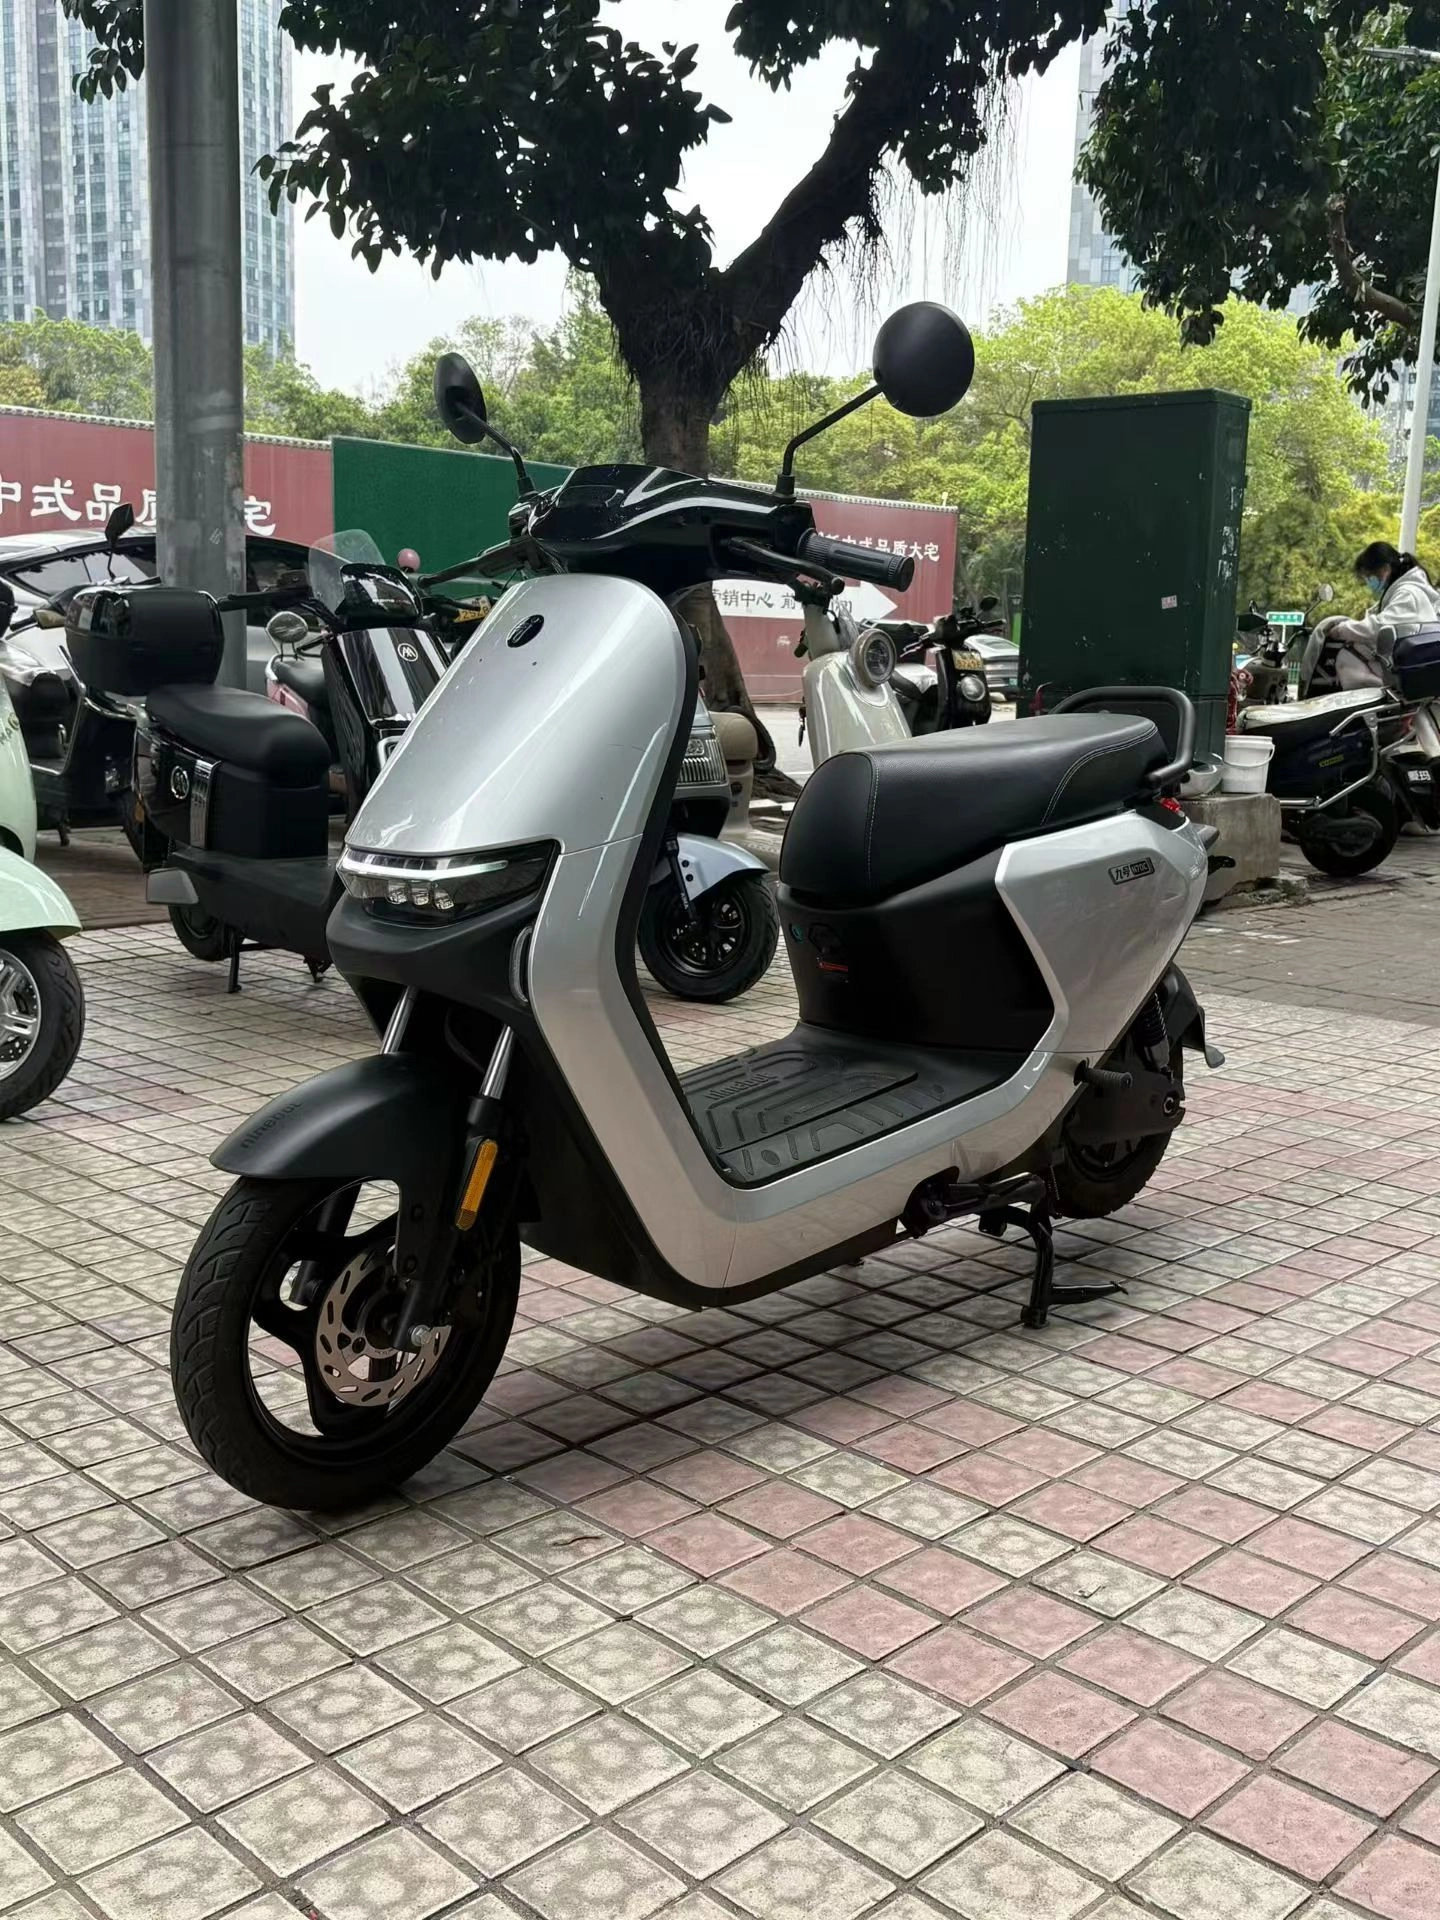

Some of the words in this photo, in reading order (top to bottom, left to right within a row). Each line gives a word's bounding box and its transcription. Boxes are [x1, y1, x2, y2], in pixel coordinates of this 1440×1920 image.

[0, 474, 276, 537] 中式品宅
[818, 531, 940, 562] 中式品质大宅
[1115, 865, 1130, 881] 九号
